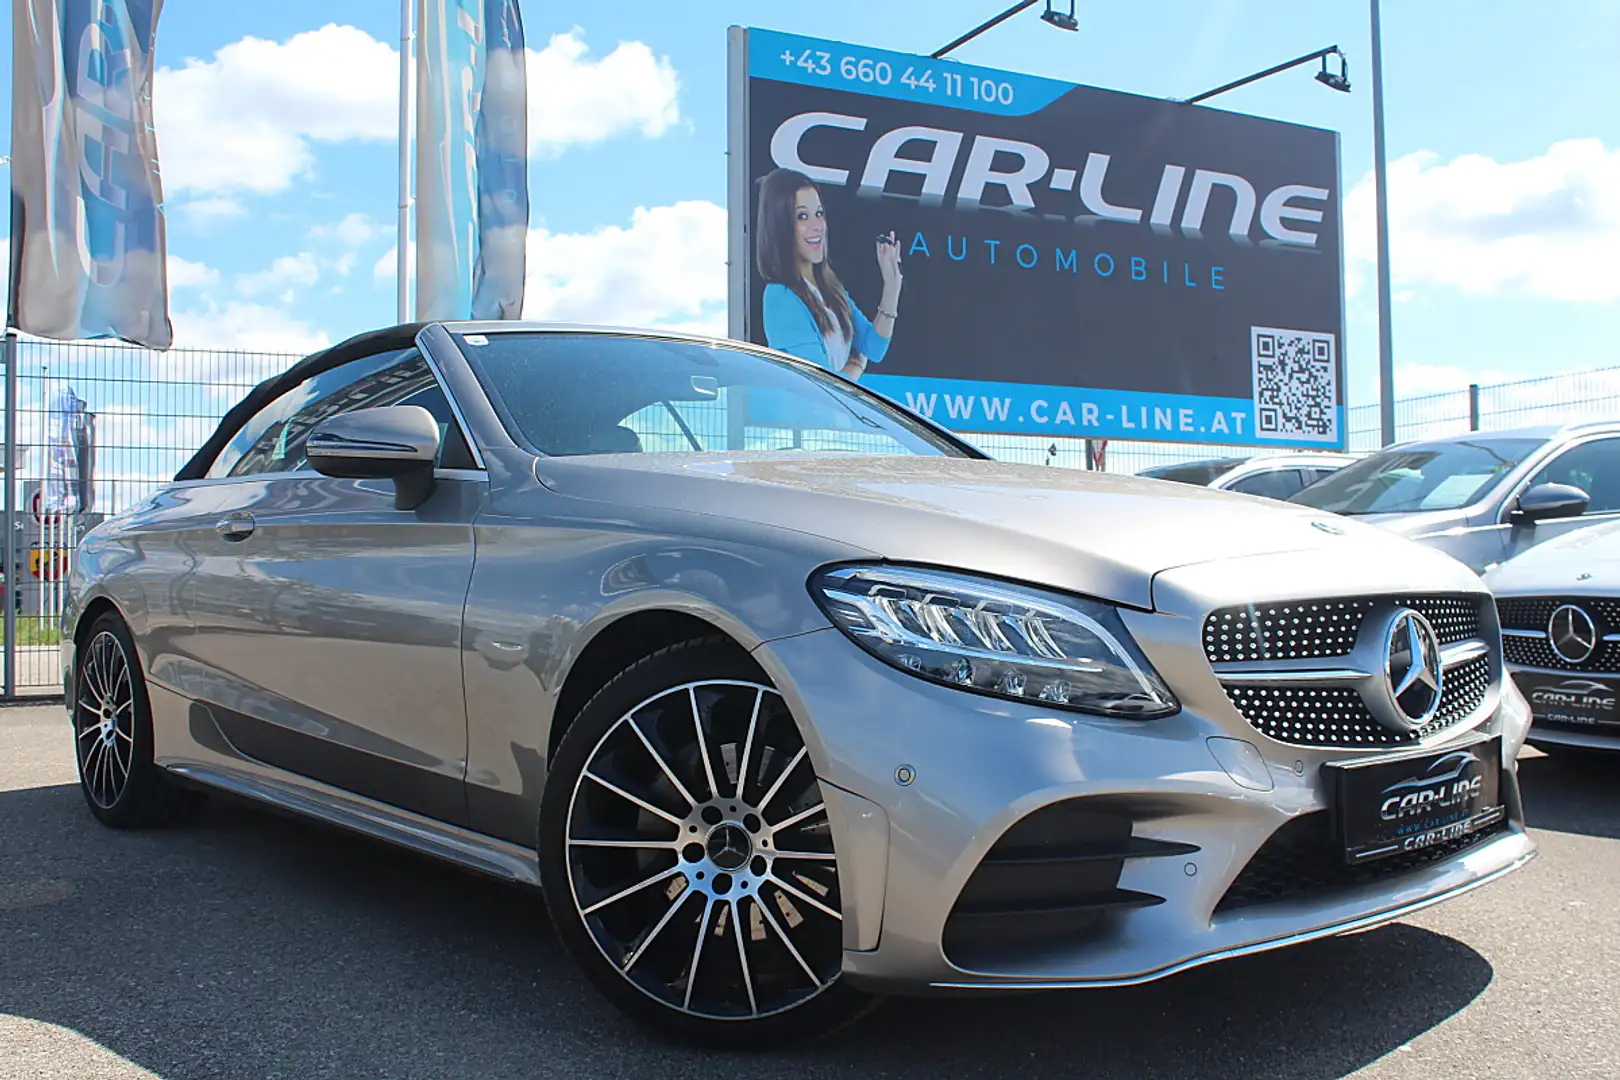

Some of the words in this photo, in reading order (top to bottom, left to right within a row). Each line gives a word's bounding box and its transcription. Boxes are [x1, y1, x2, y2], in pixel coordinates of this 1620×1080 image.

[779, 49, 832, 76] +43
[839, 55, 893, 86] 660
[899, 65, 937, 93] 44
[942, 71, 963, 98] 11
[968, 76, 1015, 106] 100
[769, 111, 1330, 245] CAR-LINE
[907, 230, 1226, 290] AUTOMOBILE
[904, 390, 1248, 435] WWW.CAR-LINE.AT
[1531, 691, 1617, 711] CAR-LINE
[1380, 775, 1483, 821] CAR-LINE
[1403, 820, 1472, 851] CAR-LINE
